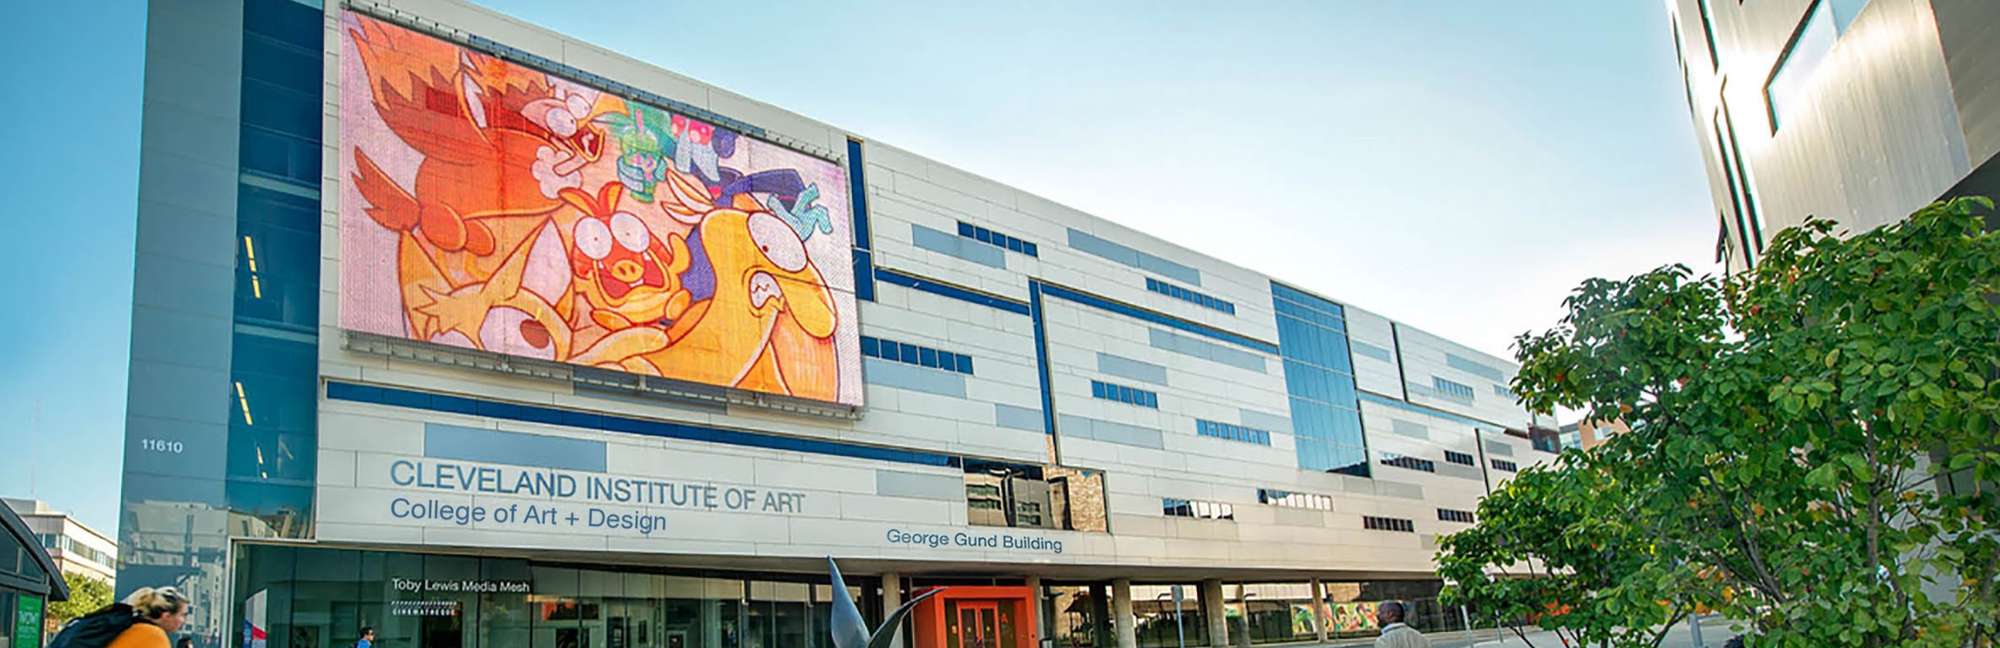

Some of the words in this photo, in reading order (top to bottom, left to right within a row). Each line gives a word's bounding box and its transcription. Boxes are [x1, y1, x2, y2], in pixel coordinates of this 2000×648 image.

[142, 438, 183, 454] 11610
[390, 460, 577, 498] CLEVELAND
[586, 476, 718, 508] INSTITUTE
[724, 487, 756, 510] OF
[762, 491, 806, 513] ART
[391, 498, 486, 525] College
[494, 504, 517, 523] of
[523, 505, 557, 525] Art
[588, 508, 666, 534] Design
[887, 529, 949, 548] George
[954, 532, 998, 548] Gund
[1002, 535, 1063, 554] Building
[392, 578, 422, 592] Toby
[424, 579, 459, 592] Lewis
[462, 581, 497, 592] Media
[499, 581, 530, 592] Mesh
